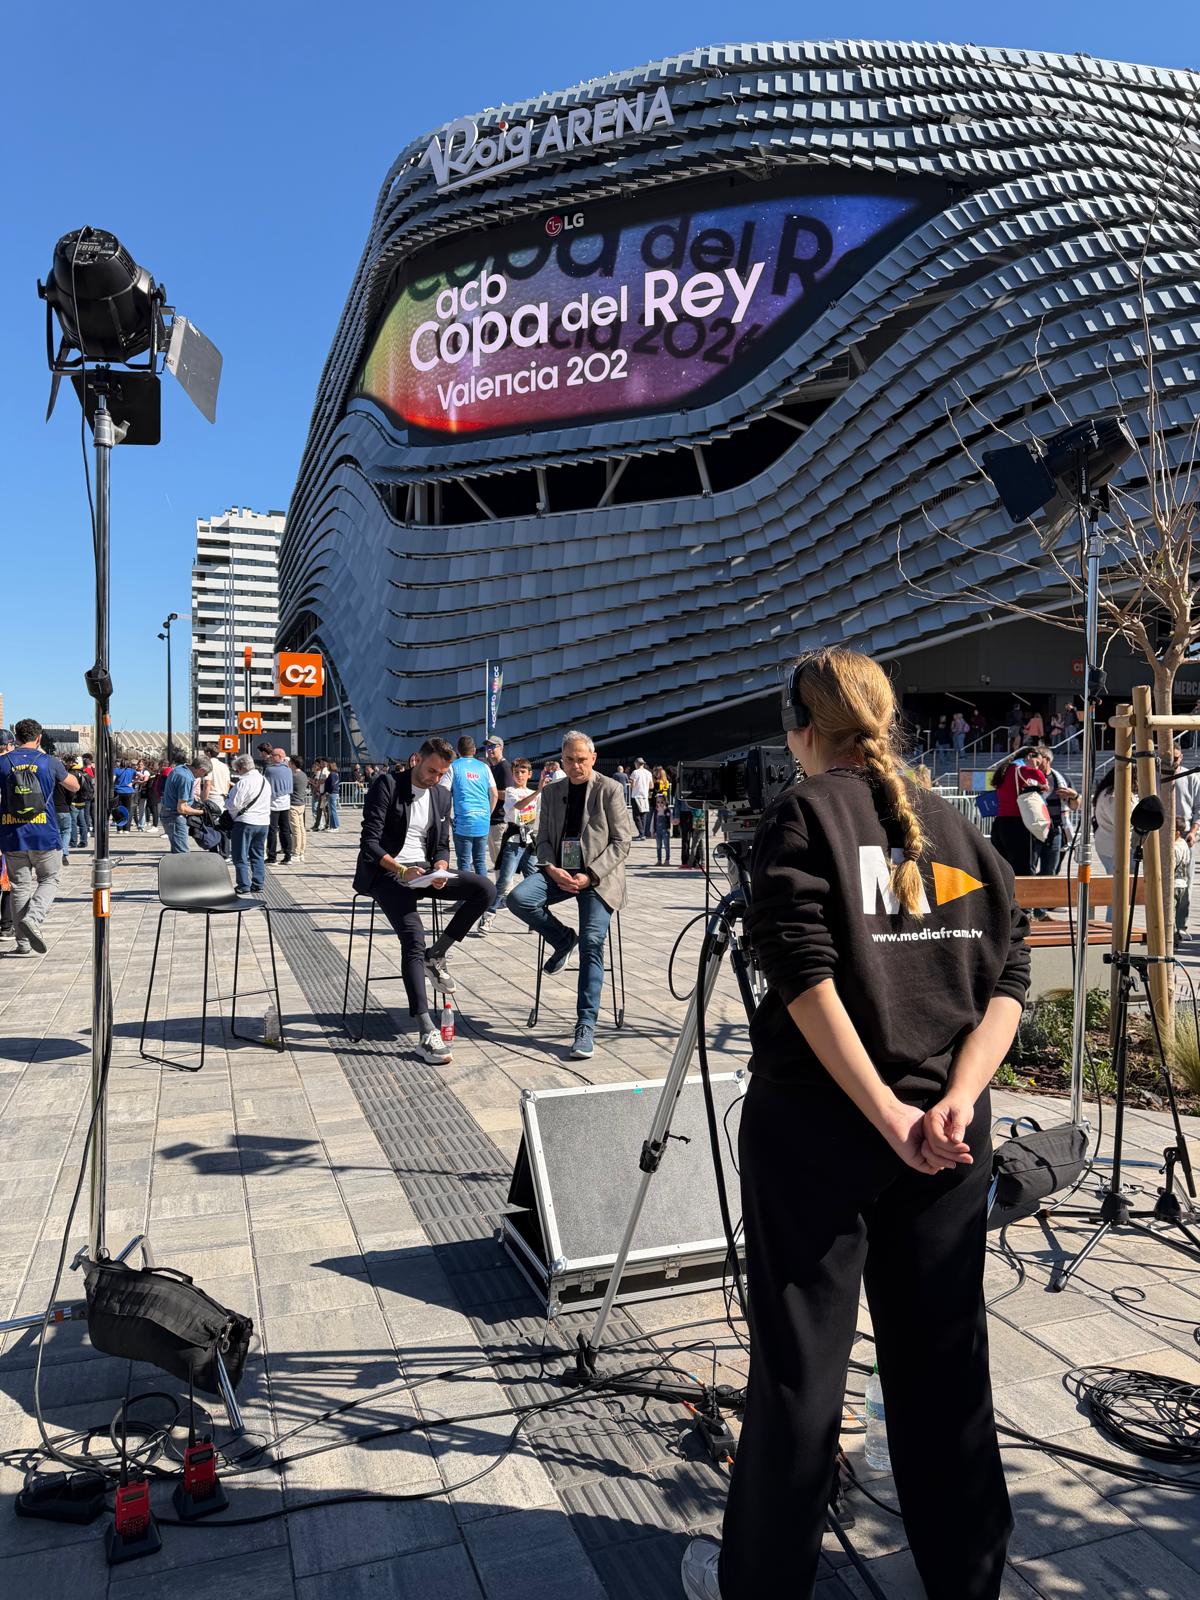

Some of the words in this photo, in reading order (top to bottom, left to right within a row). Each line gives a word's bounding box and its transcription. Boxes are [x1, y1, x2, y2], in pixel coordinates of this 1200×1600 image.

[536, 86, 675, 158] ARENA
[563, 212, 585, 231] LG
[435, 269, 508, 320] acb
[409, 301, 549, 372] Copa
[561, 285, 628, 332] del
[644, 261, 766, 327] Rey
[437, 361, 559, 411] Valencia
[566, 349, 628, 387] 202
[285, 664, 317, 684] C2
[242, 717, 258, 730] C1
[224, 738, 234, 749] B
[2, 812, 47, 824] BARONA
